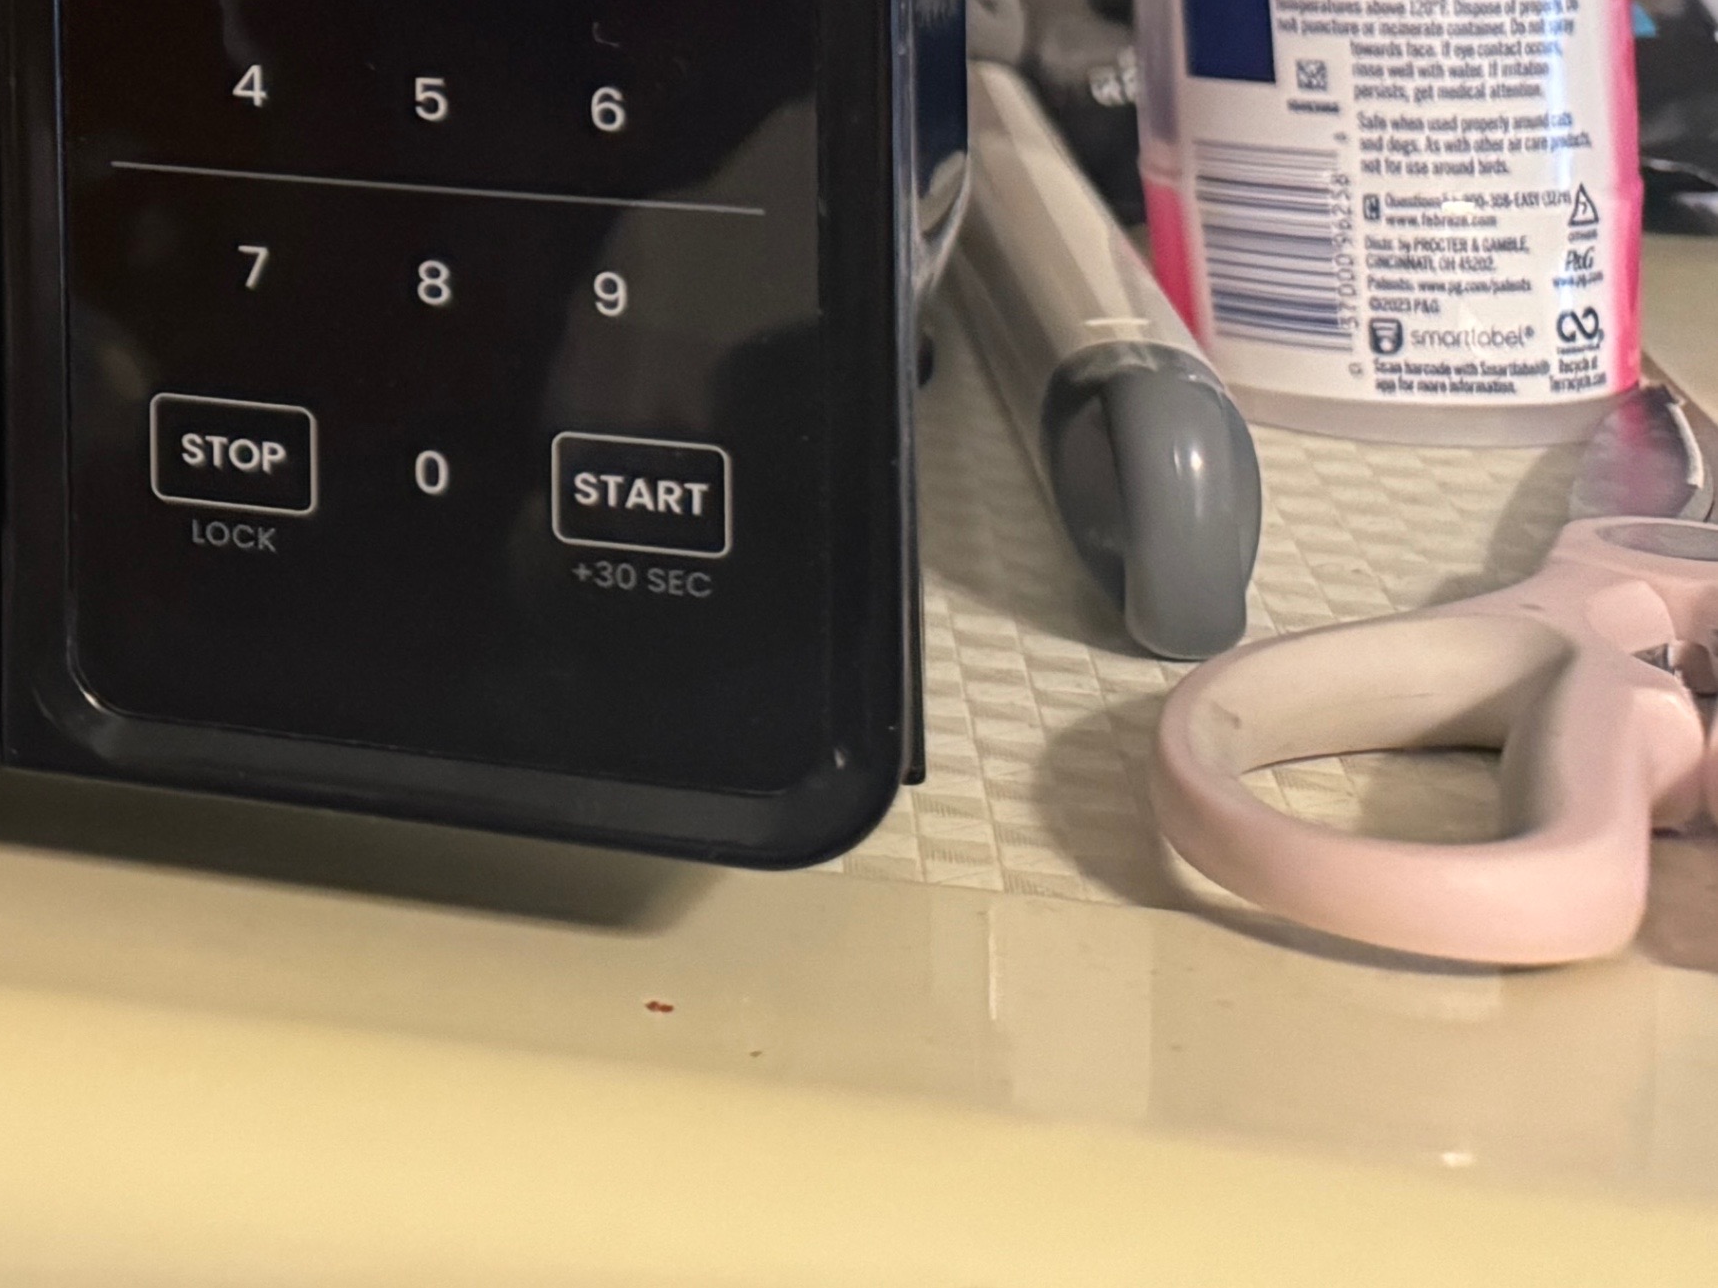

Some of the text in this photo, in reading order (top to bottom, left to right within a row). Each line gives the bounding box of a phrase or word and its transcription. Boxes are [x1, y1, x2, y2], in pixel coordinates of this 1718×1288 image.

[233, 65, 266, 106] 4
[416, 78, 447, 121] 5
[591, 87, 625, 131] 6
[239, 246, 268, 288] 7
[418, 260, 451, 305] 8
[594, 272, 627, 316] 9
[182, 433, 286, 472] STOP
[415, 450, 448, 494] 0
[575, 472, 708, 515] START
[192, 519, 275, 552] LOCK
[573, 561, 711, 597] +30 SEC
